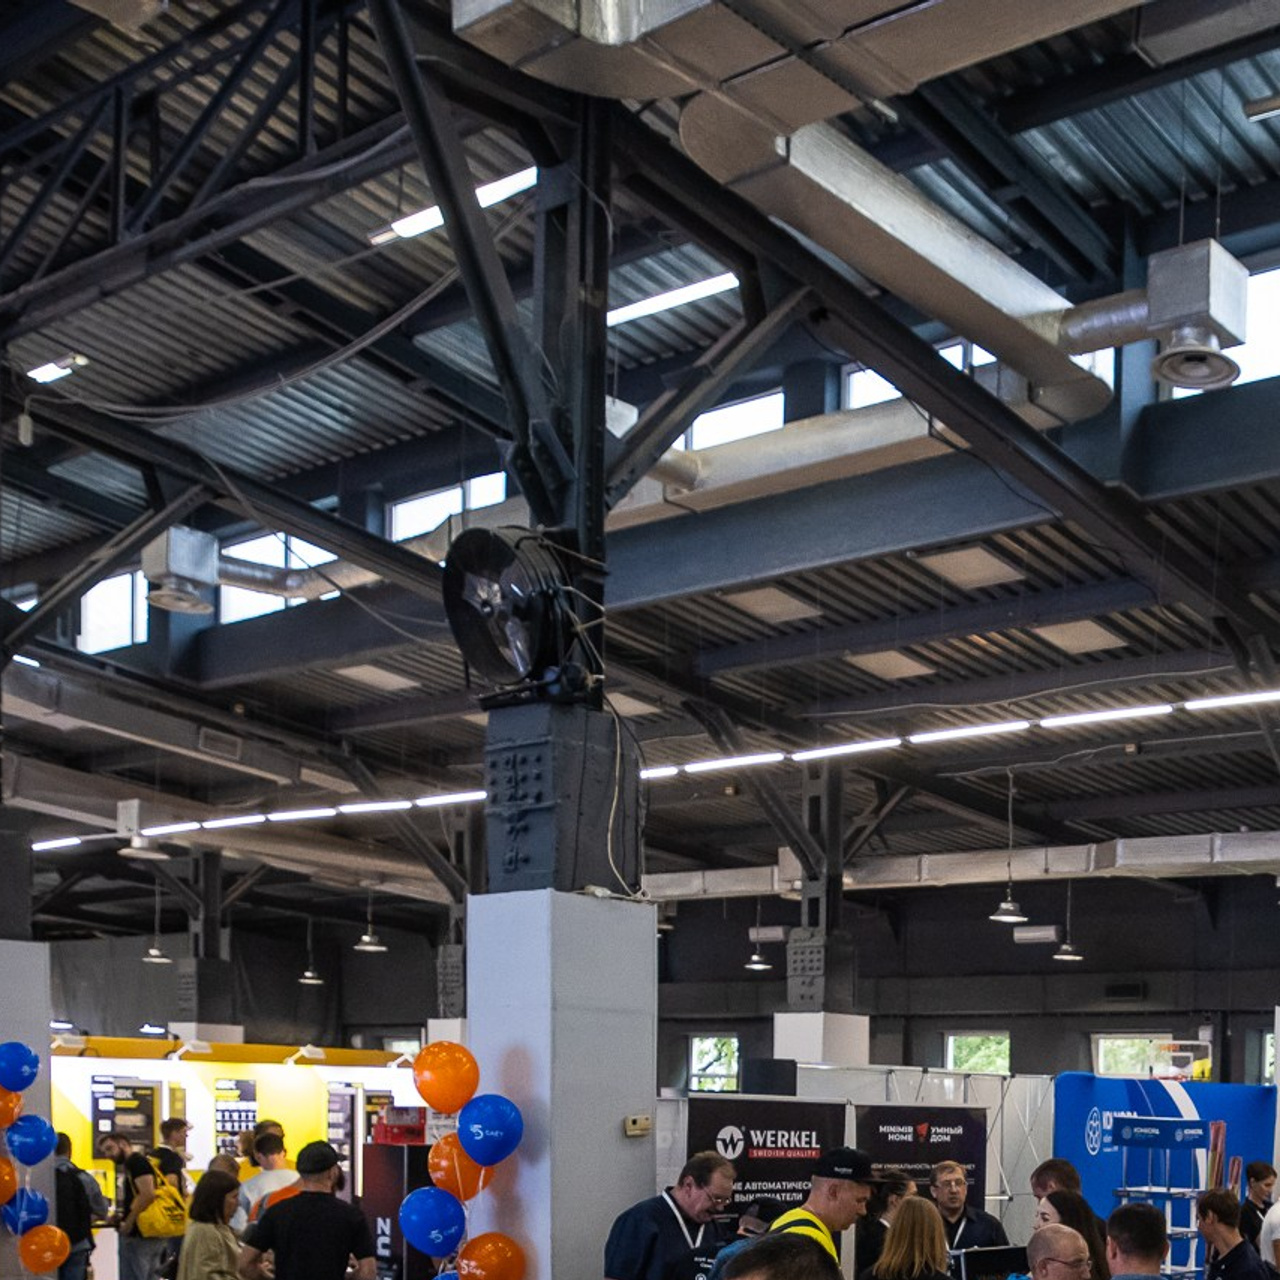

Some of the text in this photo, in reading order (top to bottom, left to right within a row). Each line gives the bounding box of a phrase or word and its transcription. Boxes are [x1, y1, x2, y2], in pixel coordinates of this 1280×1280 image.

[879, 1125, 914, 1133] MINIMIR
[930, 1126, 963, 1135] УМНЫЙ
[750, 1130, 821, 1148] WERKEL
[888, 1133, 914, 1142] HOME
[930, 1135, 951, 1143] ДОМ
[744, 1181, 812, 1190] АВТОМАТИЧЕСК
